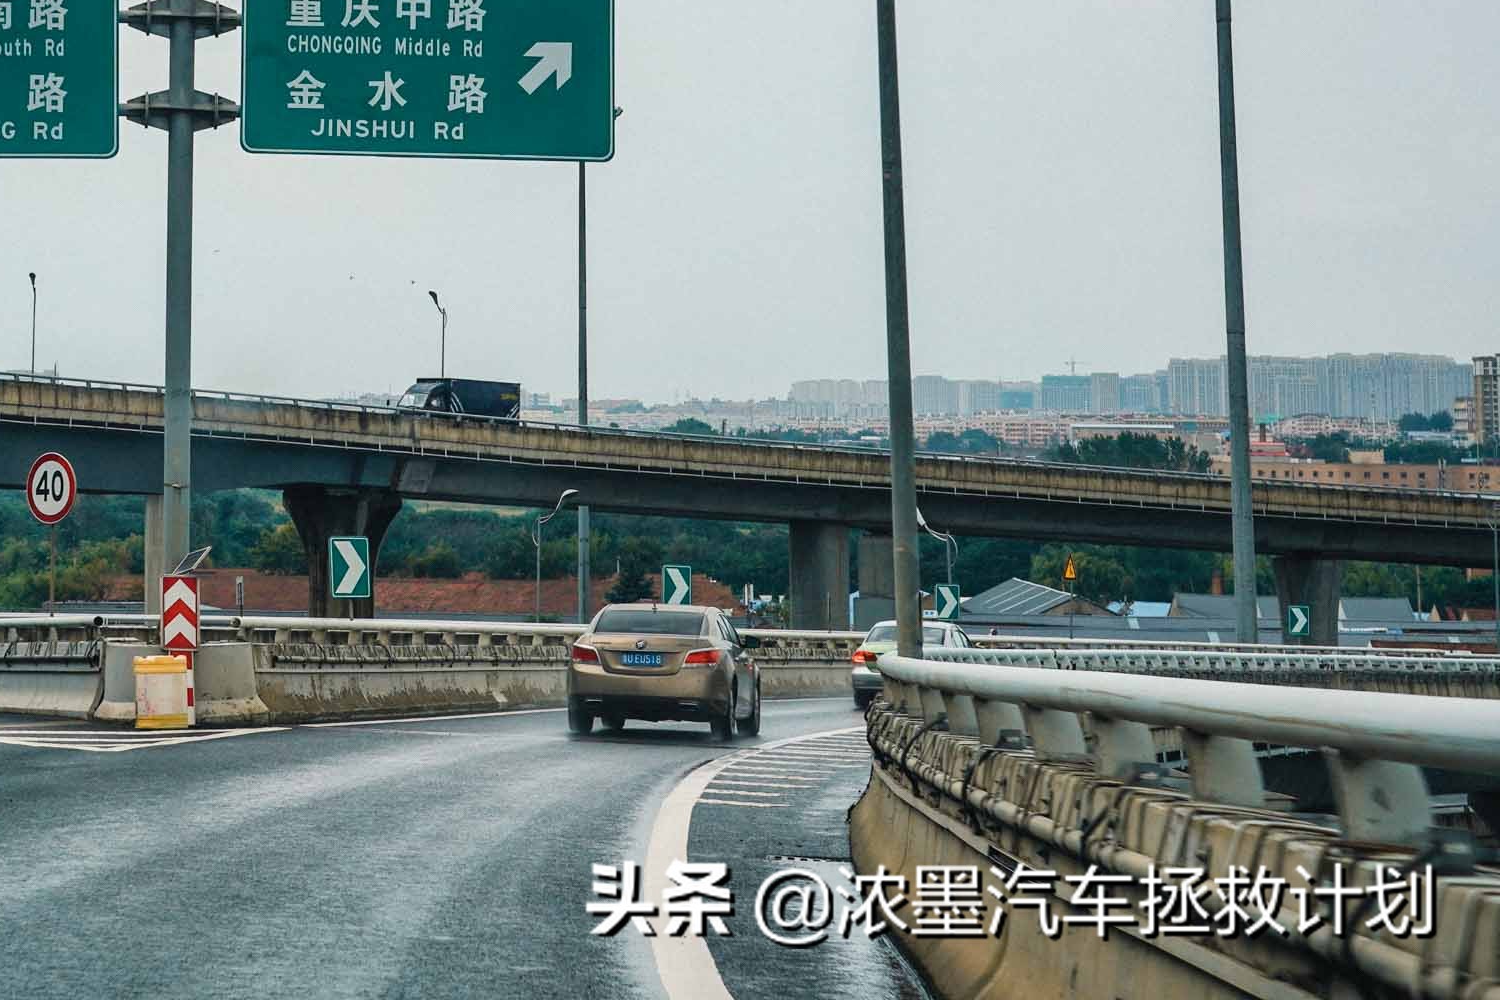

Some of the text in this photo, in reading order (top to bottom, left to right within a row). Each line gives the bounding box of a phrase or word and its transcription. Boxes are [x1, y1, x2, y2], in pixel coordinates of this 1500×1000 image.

[45, 38, 65, 57] Rd
[287, 34, 483, 57] CHONGQING Middle Rd
[286, 69, 488, 114] 金水路
[33, 121, 63, 140] Rd
[311, 118, 464, 140] JINSHUI Rd
[35, 470, 64, 502] 40
